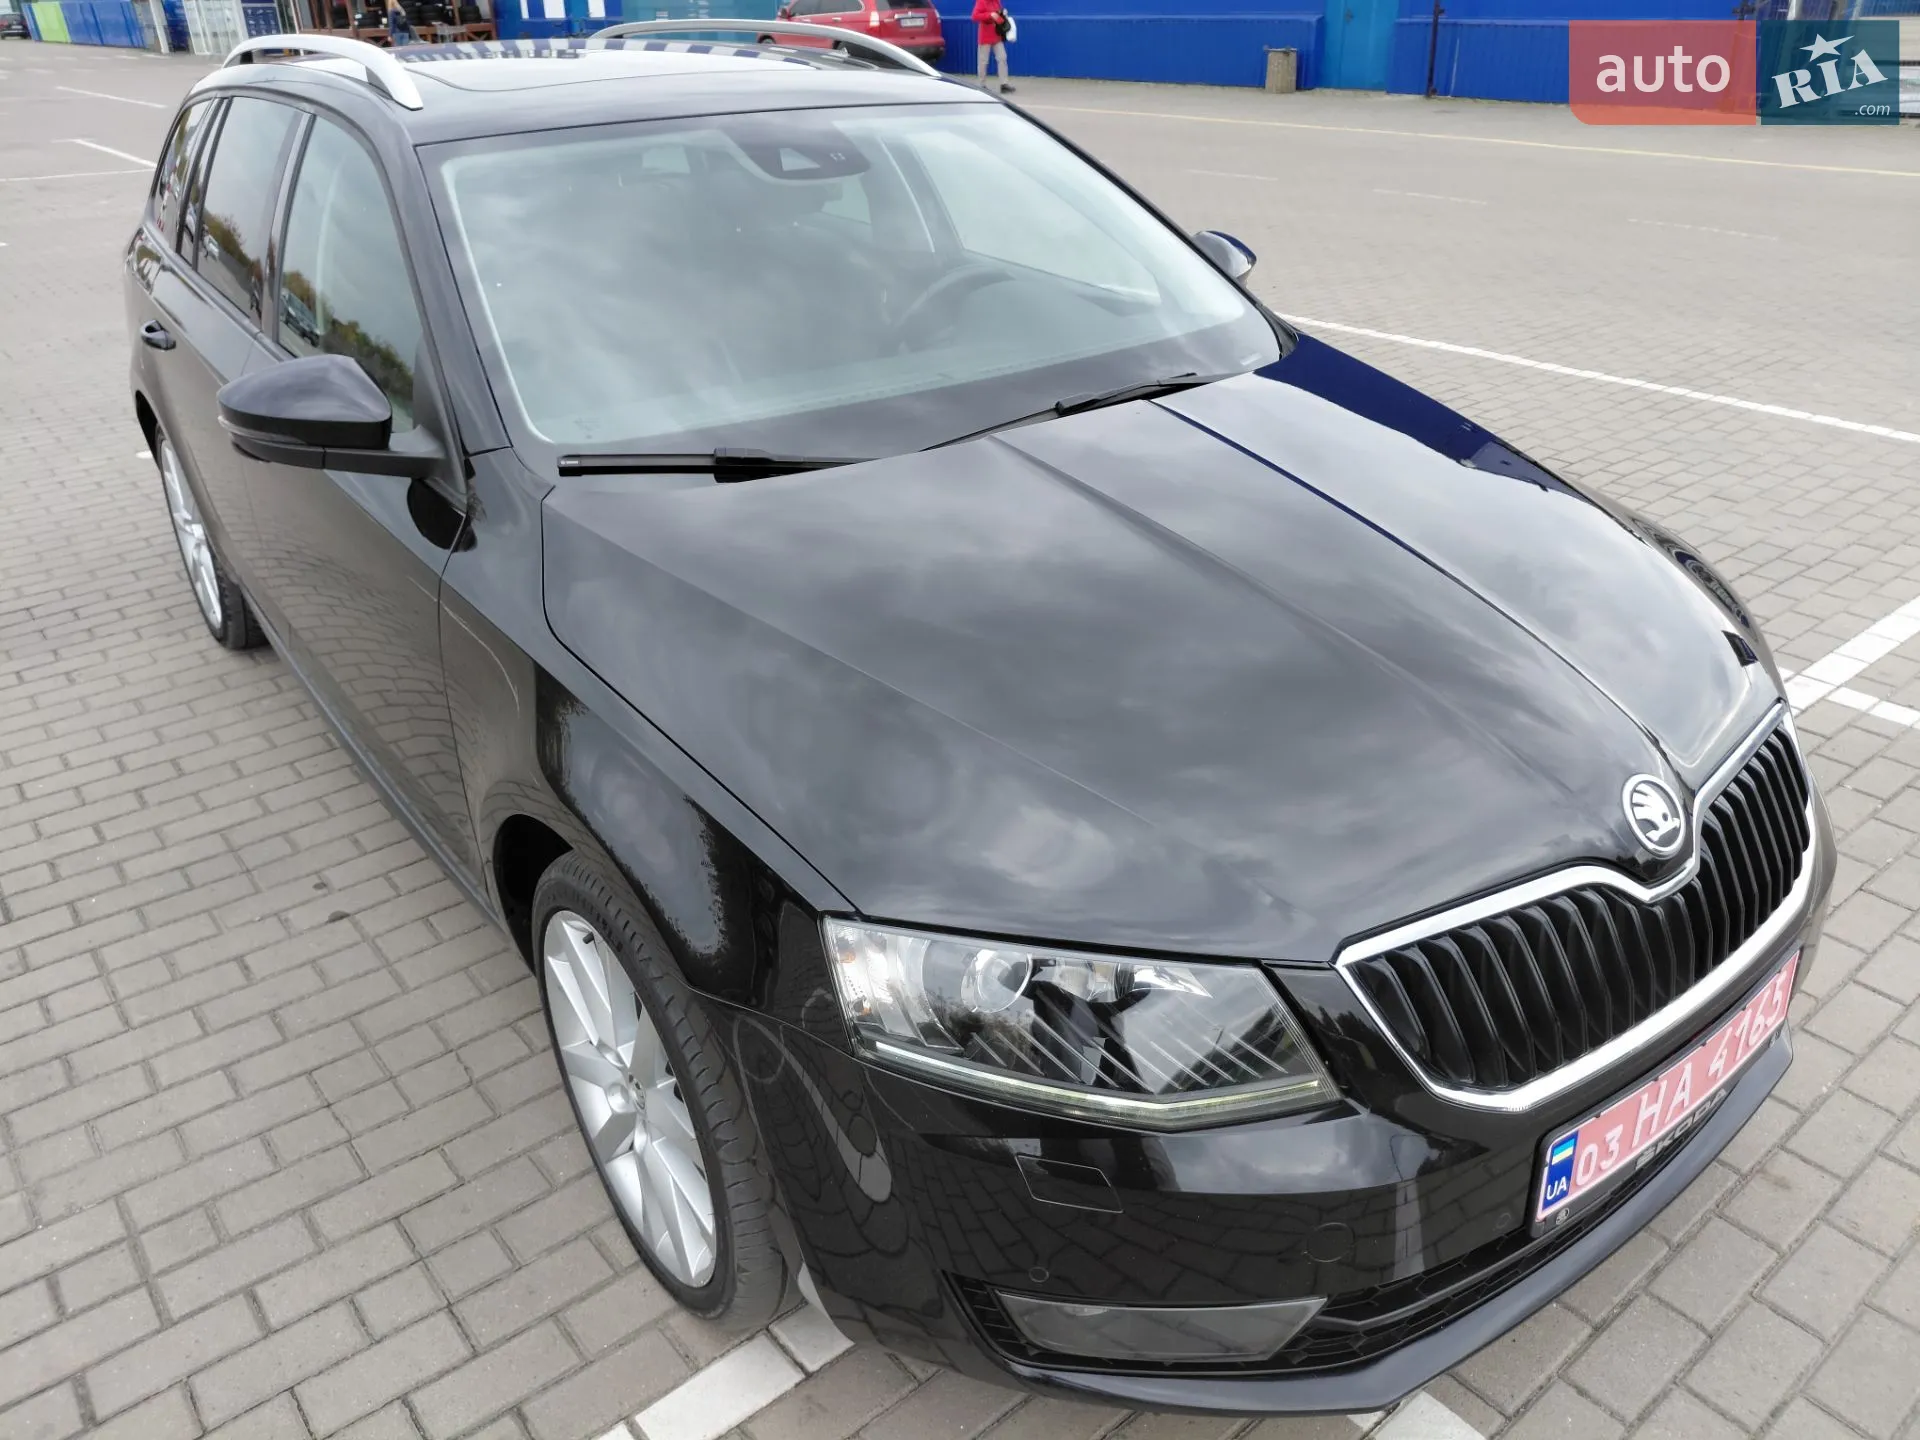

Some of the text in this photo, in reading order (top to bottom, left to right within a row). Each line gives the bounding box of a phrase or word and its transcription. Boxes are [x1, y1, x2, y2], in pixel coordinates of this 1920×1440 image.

[1575, 970, 1787, 1186] 03 HA 4165
[1546, 1175, 1568, 1201] UA
